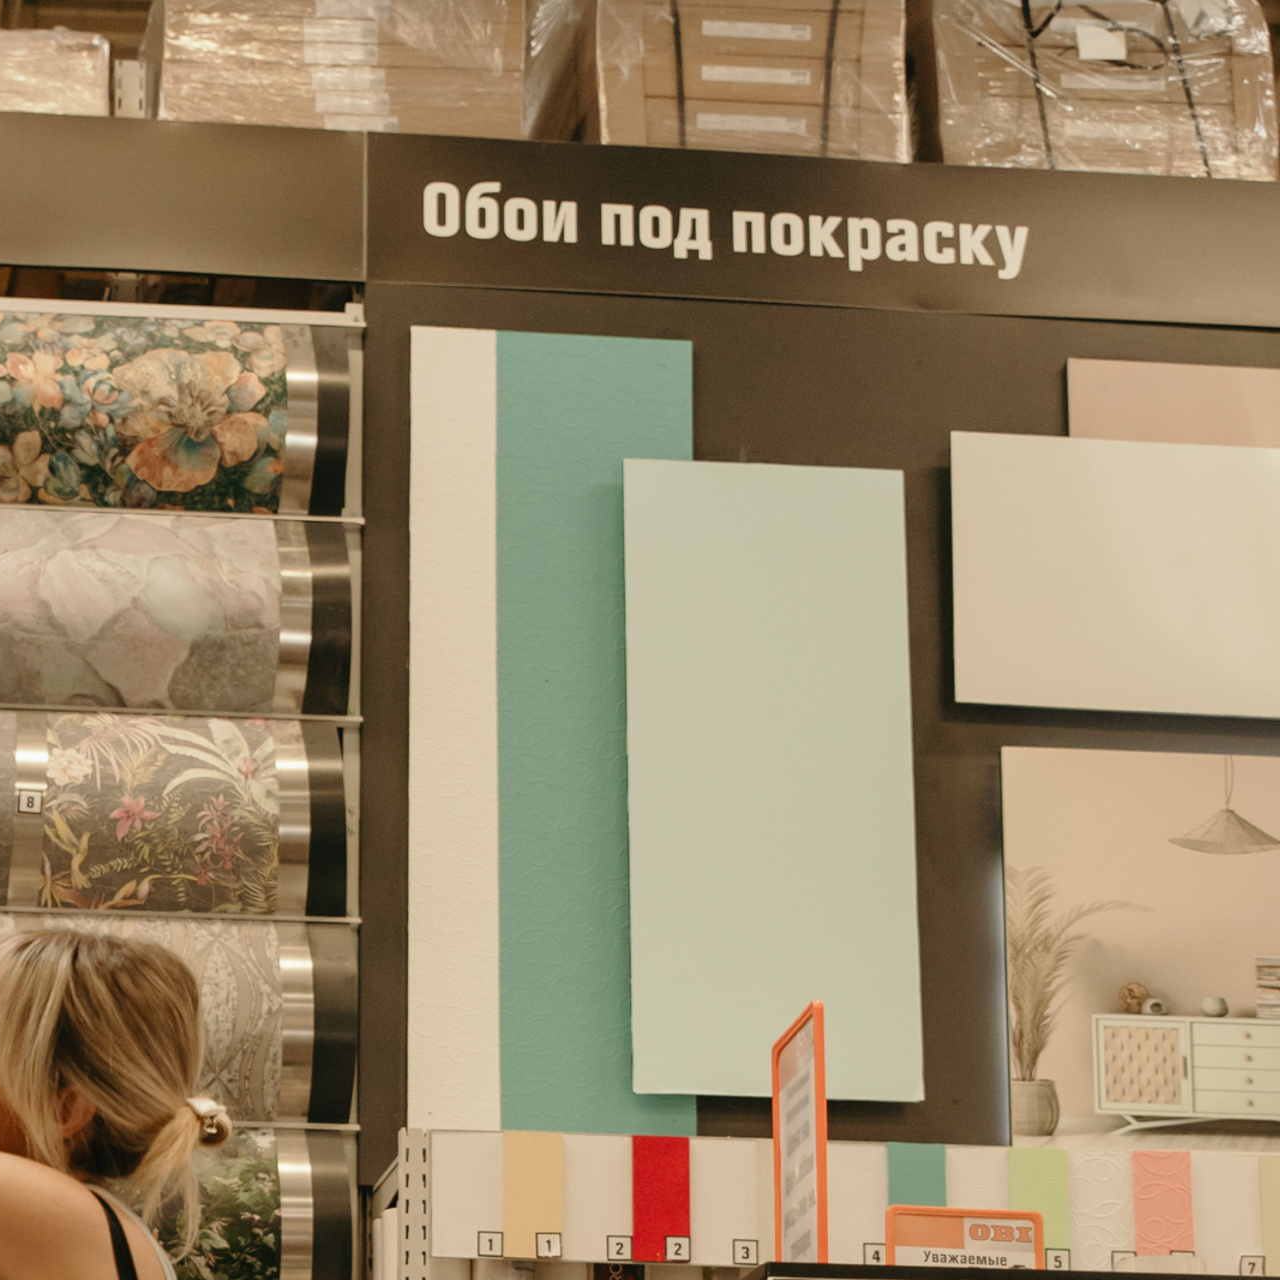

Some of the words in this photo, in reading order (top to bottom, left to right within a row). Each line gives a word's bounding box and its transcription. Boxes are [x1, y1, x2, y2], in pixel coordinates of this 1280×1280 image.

[421, 180, 579, 244] Обои
[601, 202, 713, 261] под
[731, 209, 1030, 281] покраску
[26, 796, 35, 809] 8
[969, 1223, 1033, 1243] OBI
[486, 1239, 493, 1251] 1
[545, 1239, 552, 1252] 1
[615, 1242, 624, 1255] 2
[673, 1242, 682, 1256] 2
[741, 1246, 750, 1259] 3
[871, 1250, 880, 1263] 4
[923, 1250, 1008, 1266] Уважаемые
[1053, 1255, 1062, 1269] 5
[1247, 1262, 1255, 1274] 7
